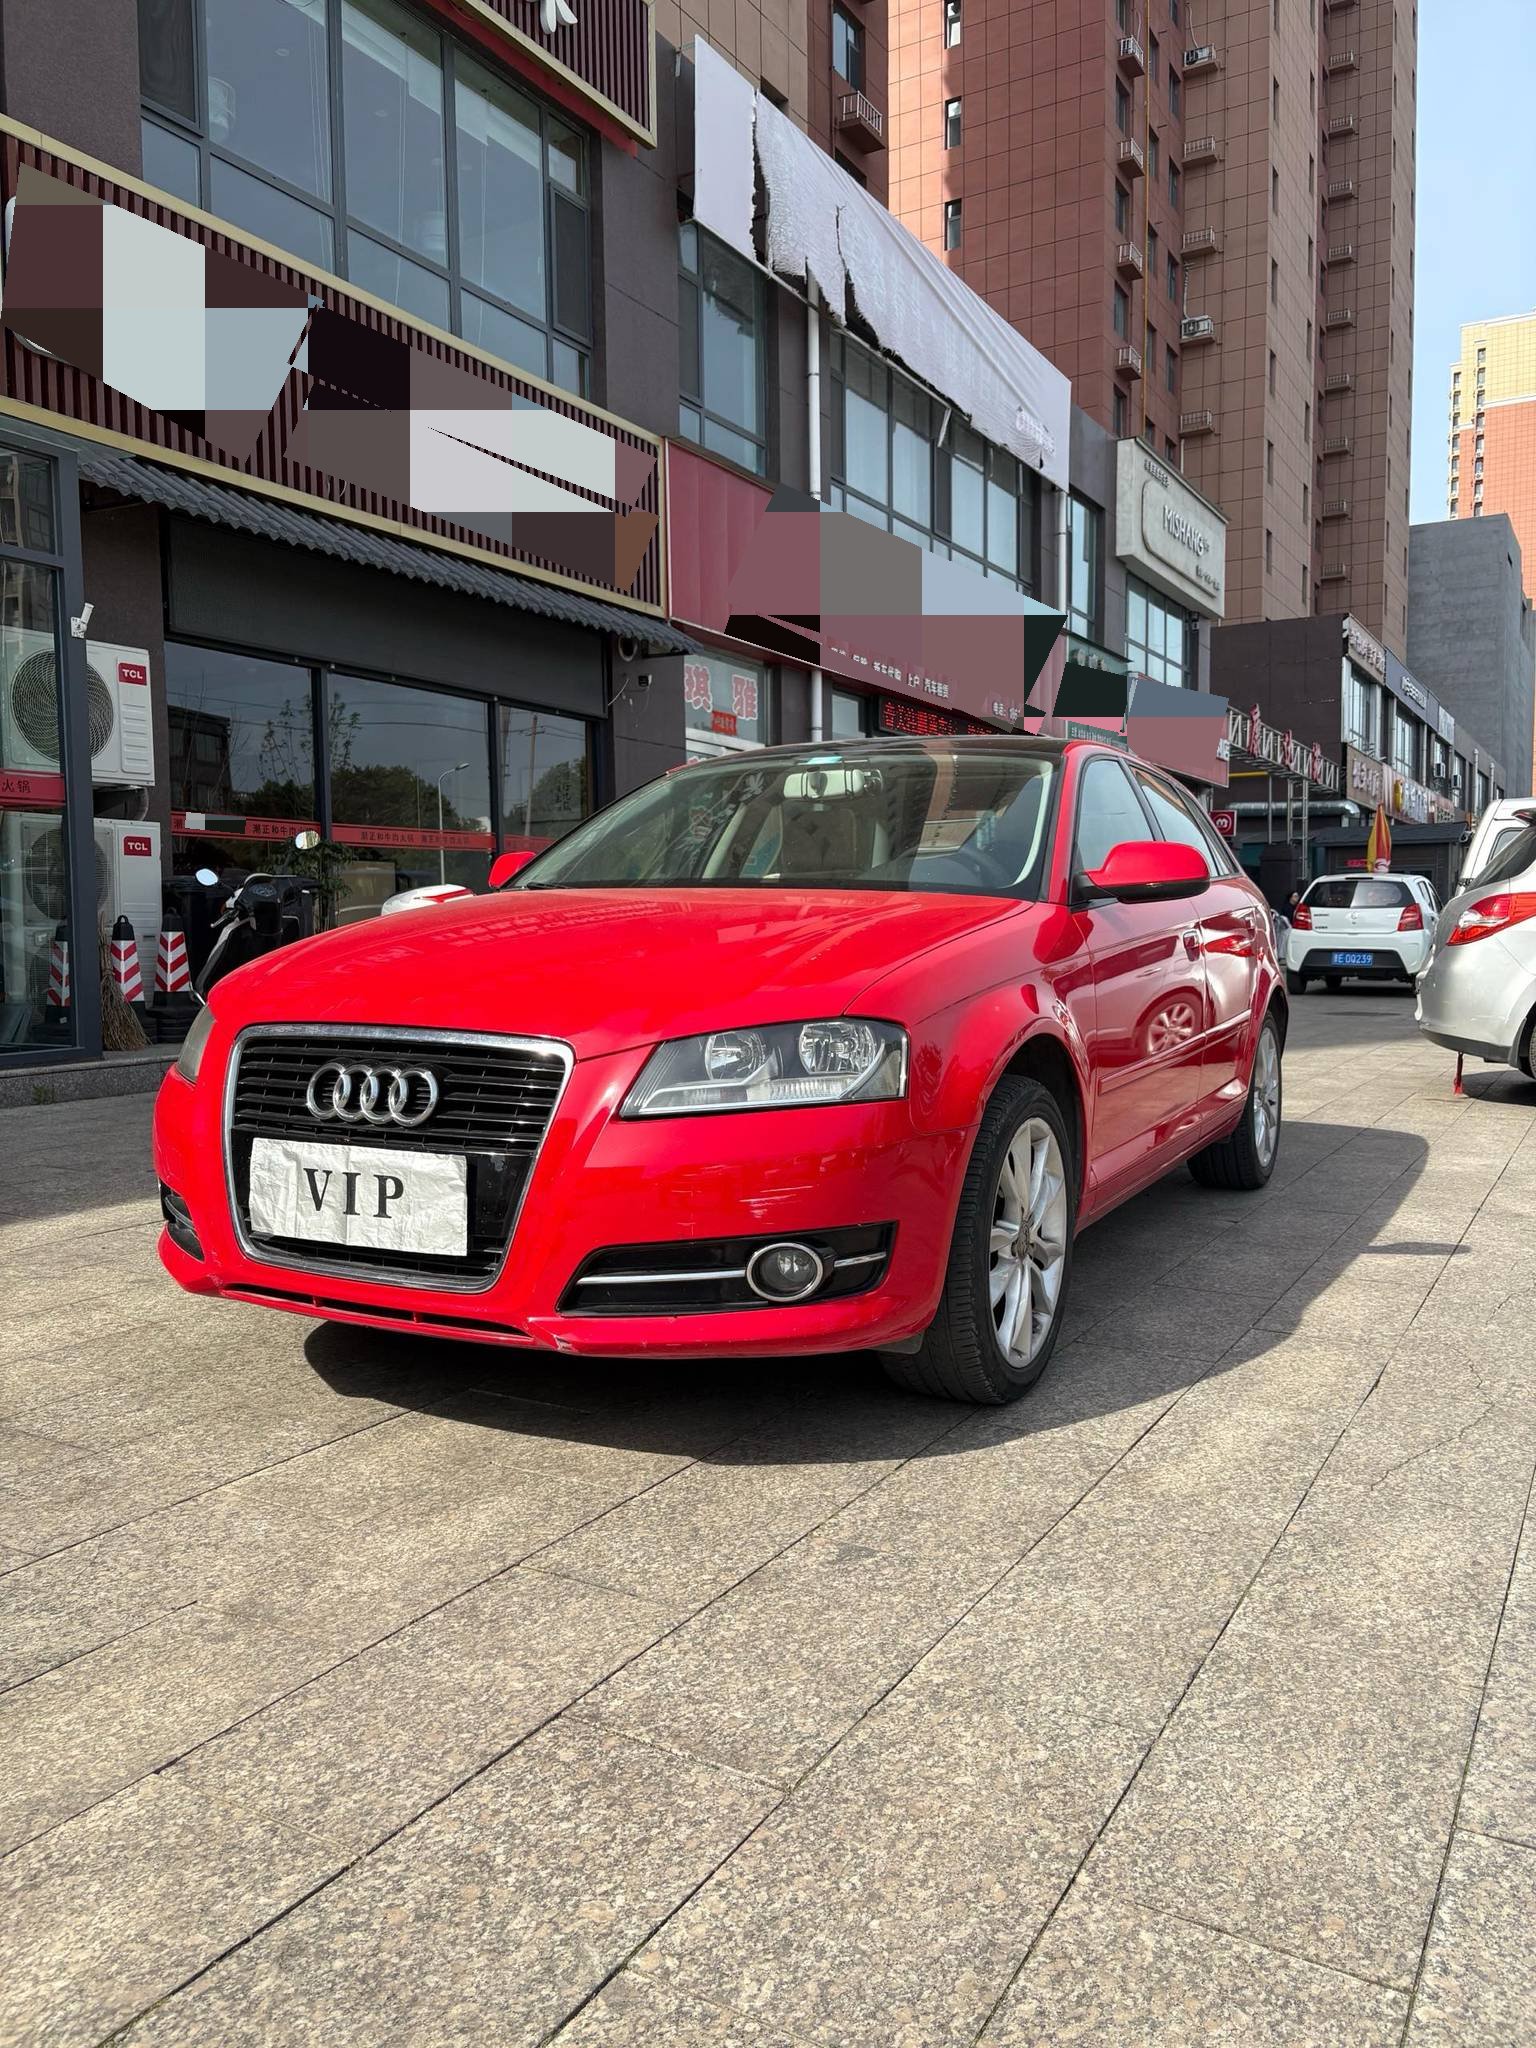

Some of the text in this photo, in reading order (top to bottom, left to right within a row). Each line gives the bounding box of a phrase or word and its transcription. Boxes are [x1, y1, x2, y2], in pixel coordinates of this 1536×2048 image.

[1163, 504, 1204, 556] MISHANG
[122, 668, 143, 680] TCL
[2, 778, 31, 793] 火锅
[127, 841, 148, 851] TCL
[303, 1167, 404, 1219] VIP
